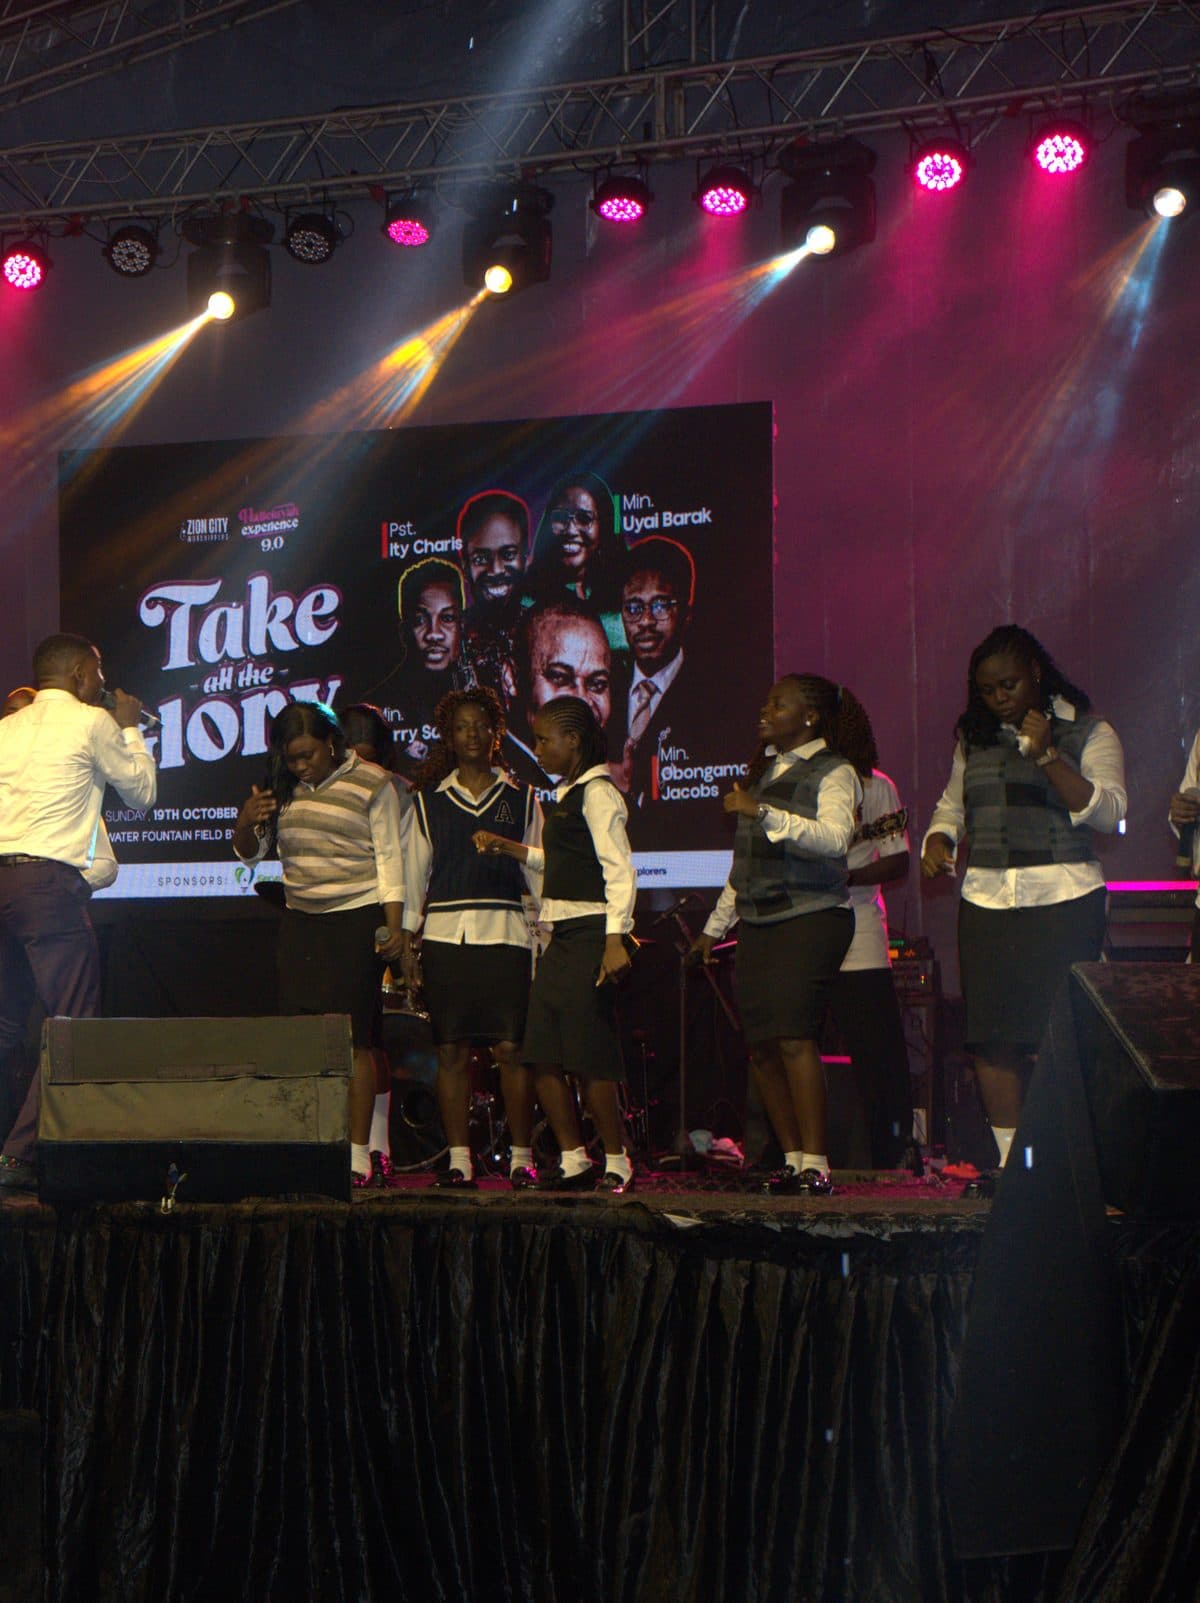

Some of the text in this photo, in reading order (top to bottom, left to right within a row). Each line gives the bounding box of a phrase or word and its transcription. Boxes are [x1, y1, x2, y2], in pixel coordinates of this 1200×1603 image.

[623, 493, 654, 510] Min.
[187, 517, 228, 535] ZION CITY
[241, 519, 299, 536] experience
[623, 507, 712, 533] Uyai Barak
[389, 521, 416, 537] Pst.
[261, 536, 284, 552] 9.0
[412, 536, 463, 554] Charis
[139, 574, 340, 671] Take
[203, 662, 274, 694] all the
[661, 746, 689, 761] Min.
[661, 784, 719, 800] Jacobs
[153, 808, 179, 821] 19TH
[182, 807, 238, 820] OCTOBER
[142, 829, 192, 841] FOUNTAIN
[194, 829, 222, 841] FIELD
